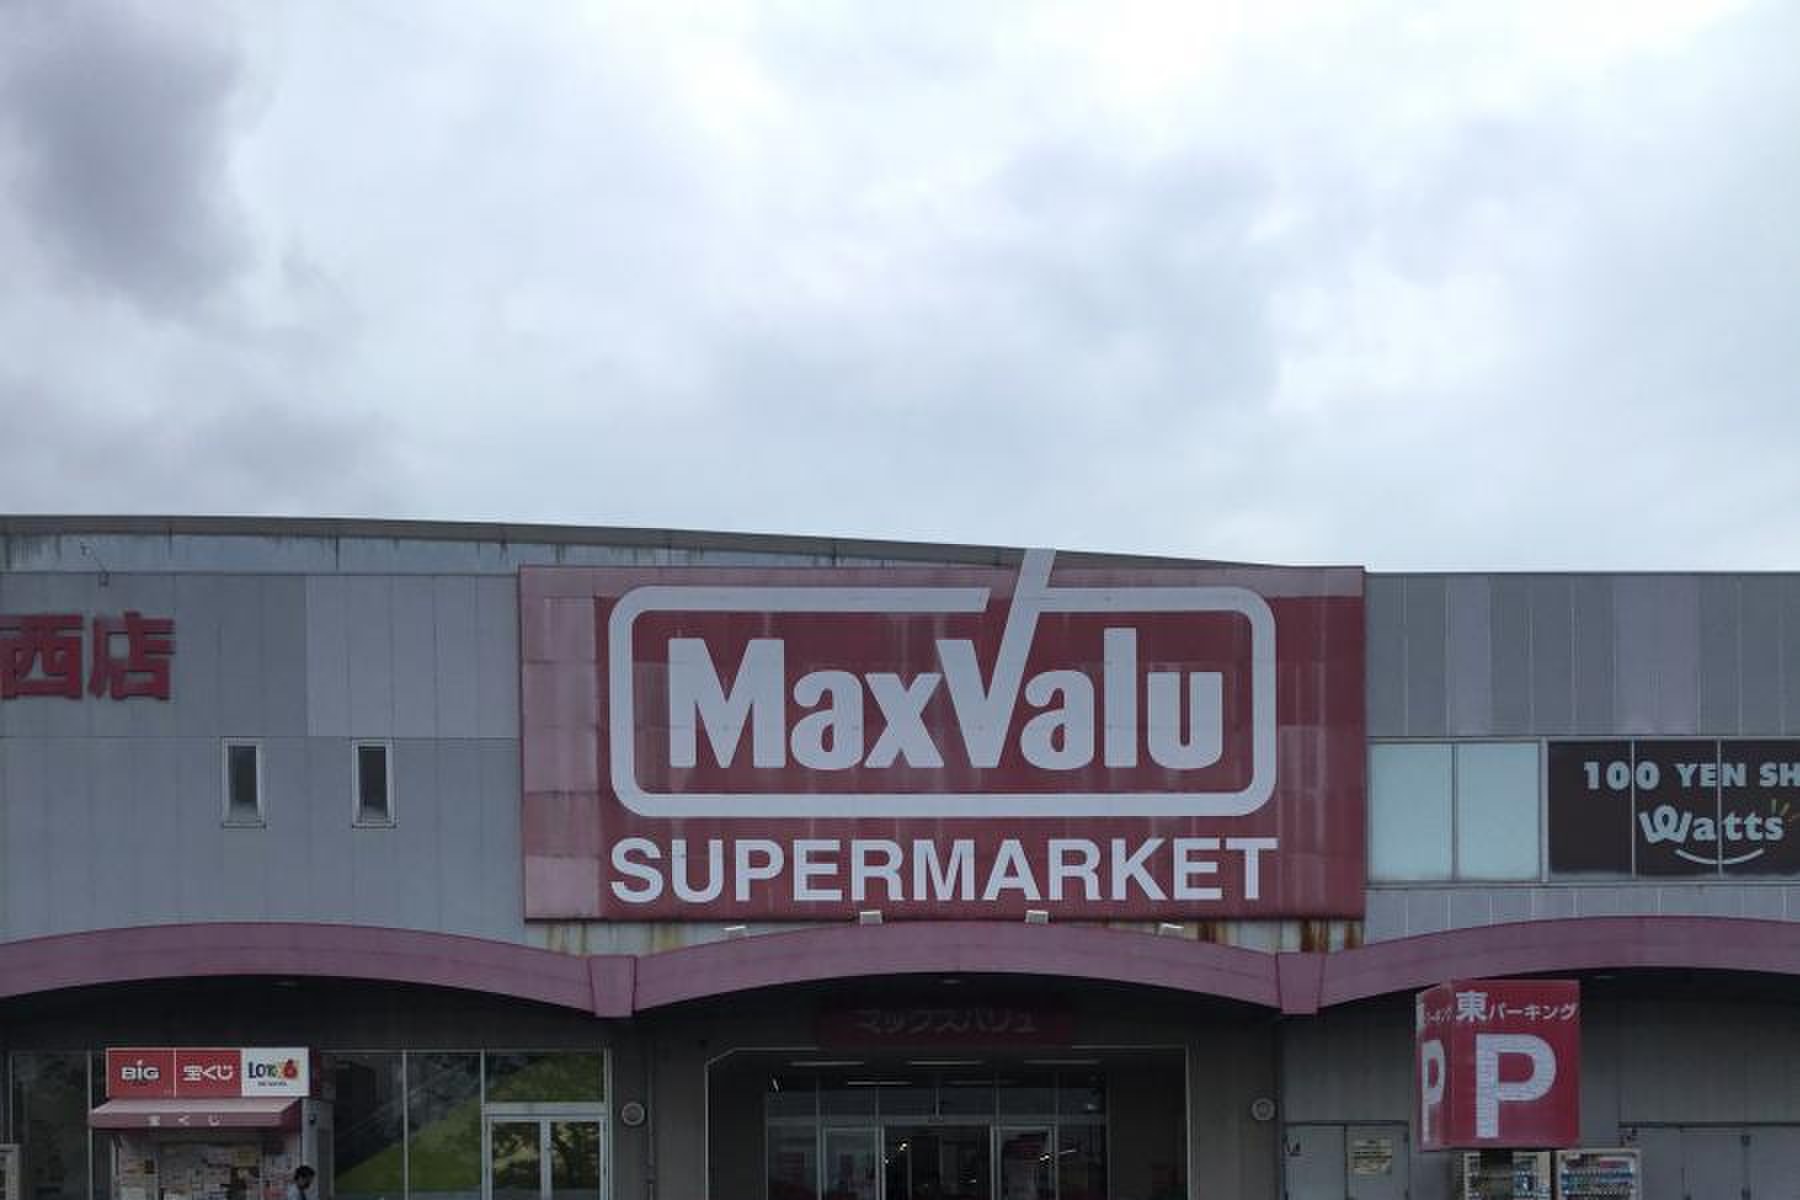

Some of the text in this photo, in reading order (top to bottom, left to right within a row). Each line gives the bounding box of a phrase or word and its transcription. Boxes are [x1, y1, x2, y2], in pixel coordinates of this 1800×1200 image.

[0, 611, 175, 700] 西店
[667, 549, 1224, 770] MaxValu
[1584, 761, 1800, 790] 100 YEN SH
[1639, 805, 1785, 843] Watts
[610, 836, 1279, 904] SUPERMARKET
[1475, 1033, 1557, 1139] P
